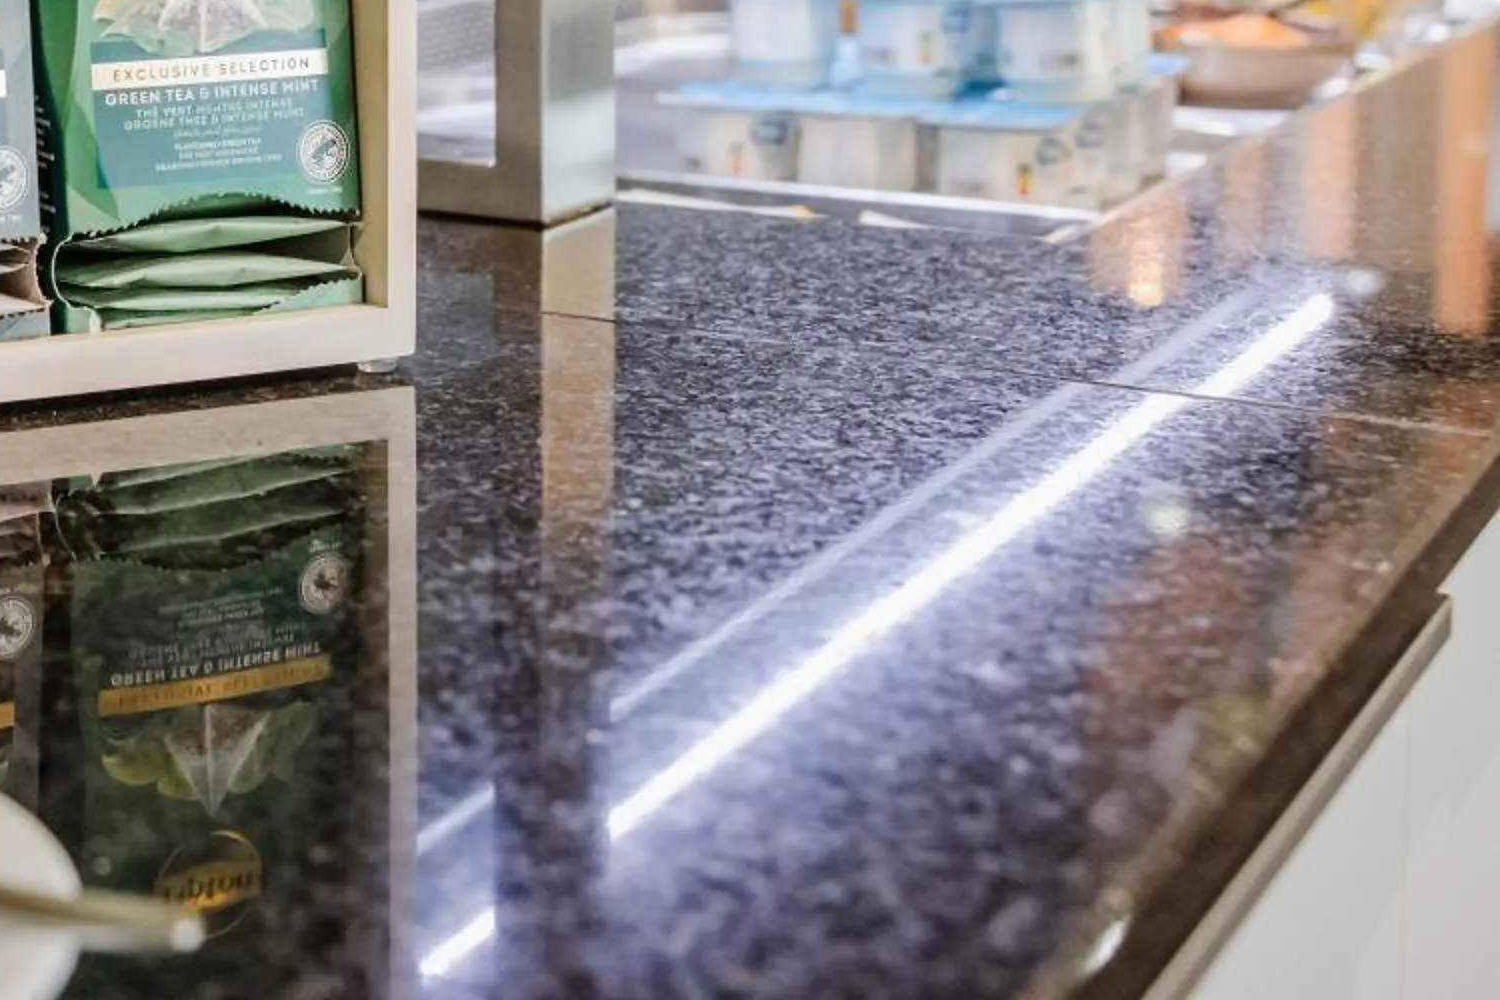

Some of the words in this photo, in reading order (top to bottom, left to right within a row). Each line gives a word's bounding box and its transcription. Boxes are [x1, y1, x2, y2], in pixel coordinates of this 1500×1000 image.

[113, 63, 208, 83] EXCLUSIVE
[219, 56, 310, 76] SELECTION
[104, 91, 161, 107] GREEN
[164, 88, 196, 104] TEA
[215, 83, 277, 98] INTENSE
[282, 79, 319, 96] MINT
